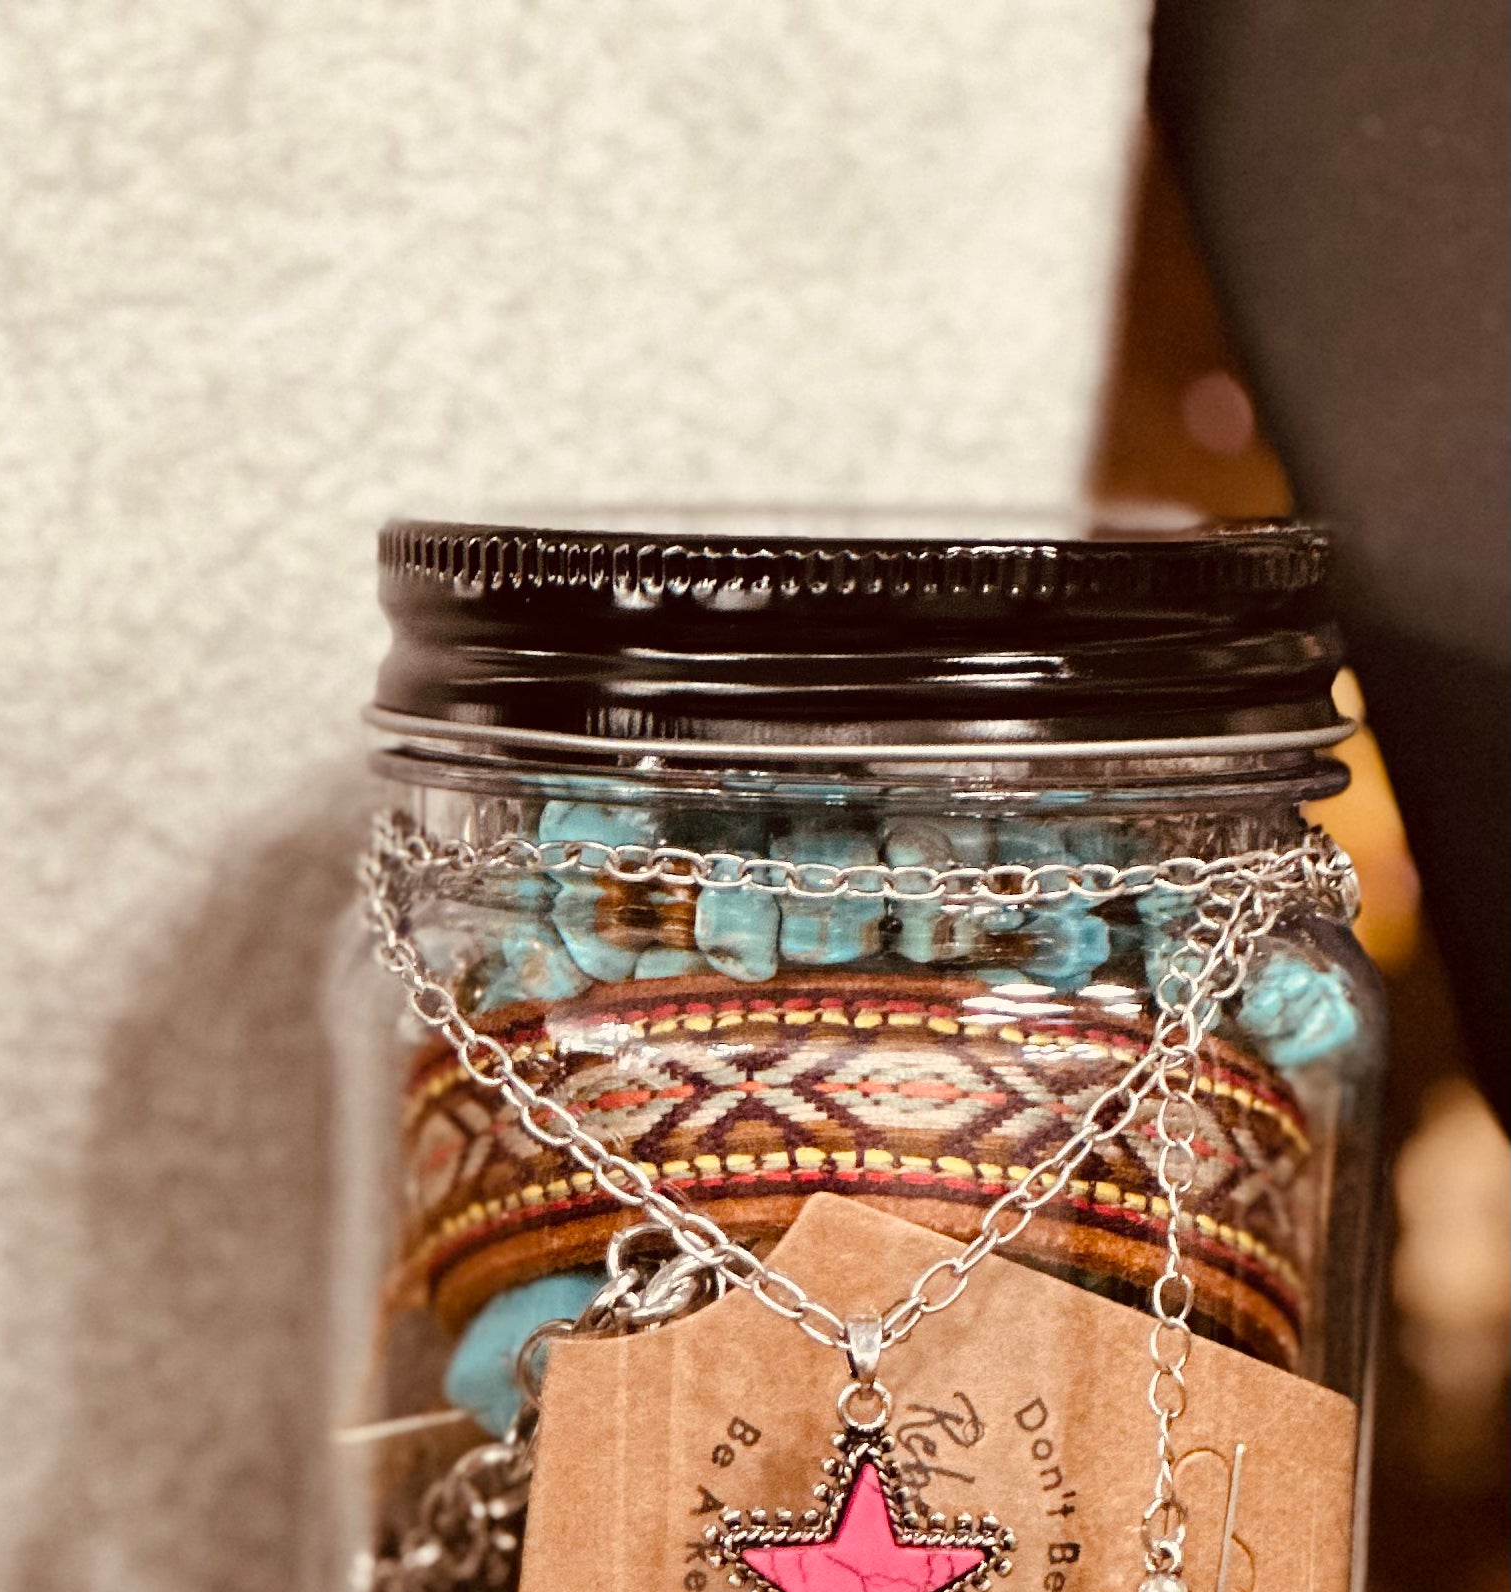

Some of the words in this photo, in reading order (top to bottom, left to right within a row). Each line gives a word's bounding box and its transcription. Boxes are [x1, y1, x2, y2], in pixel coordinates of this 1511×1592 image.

[711, 1416, 762, 1467] Be
[1014, 1397, 1077, 1518] Don't
[690, 1484, 725, 1515] A
[1043, 1542, 1081, 1592] Be
